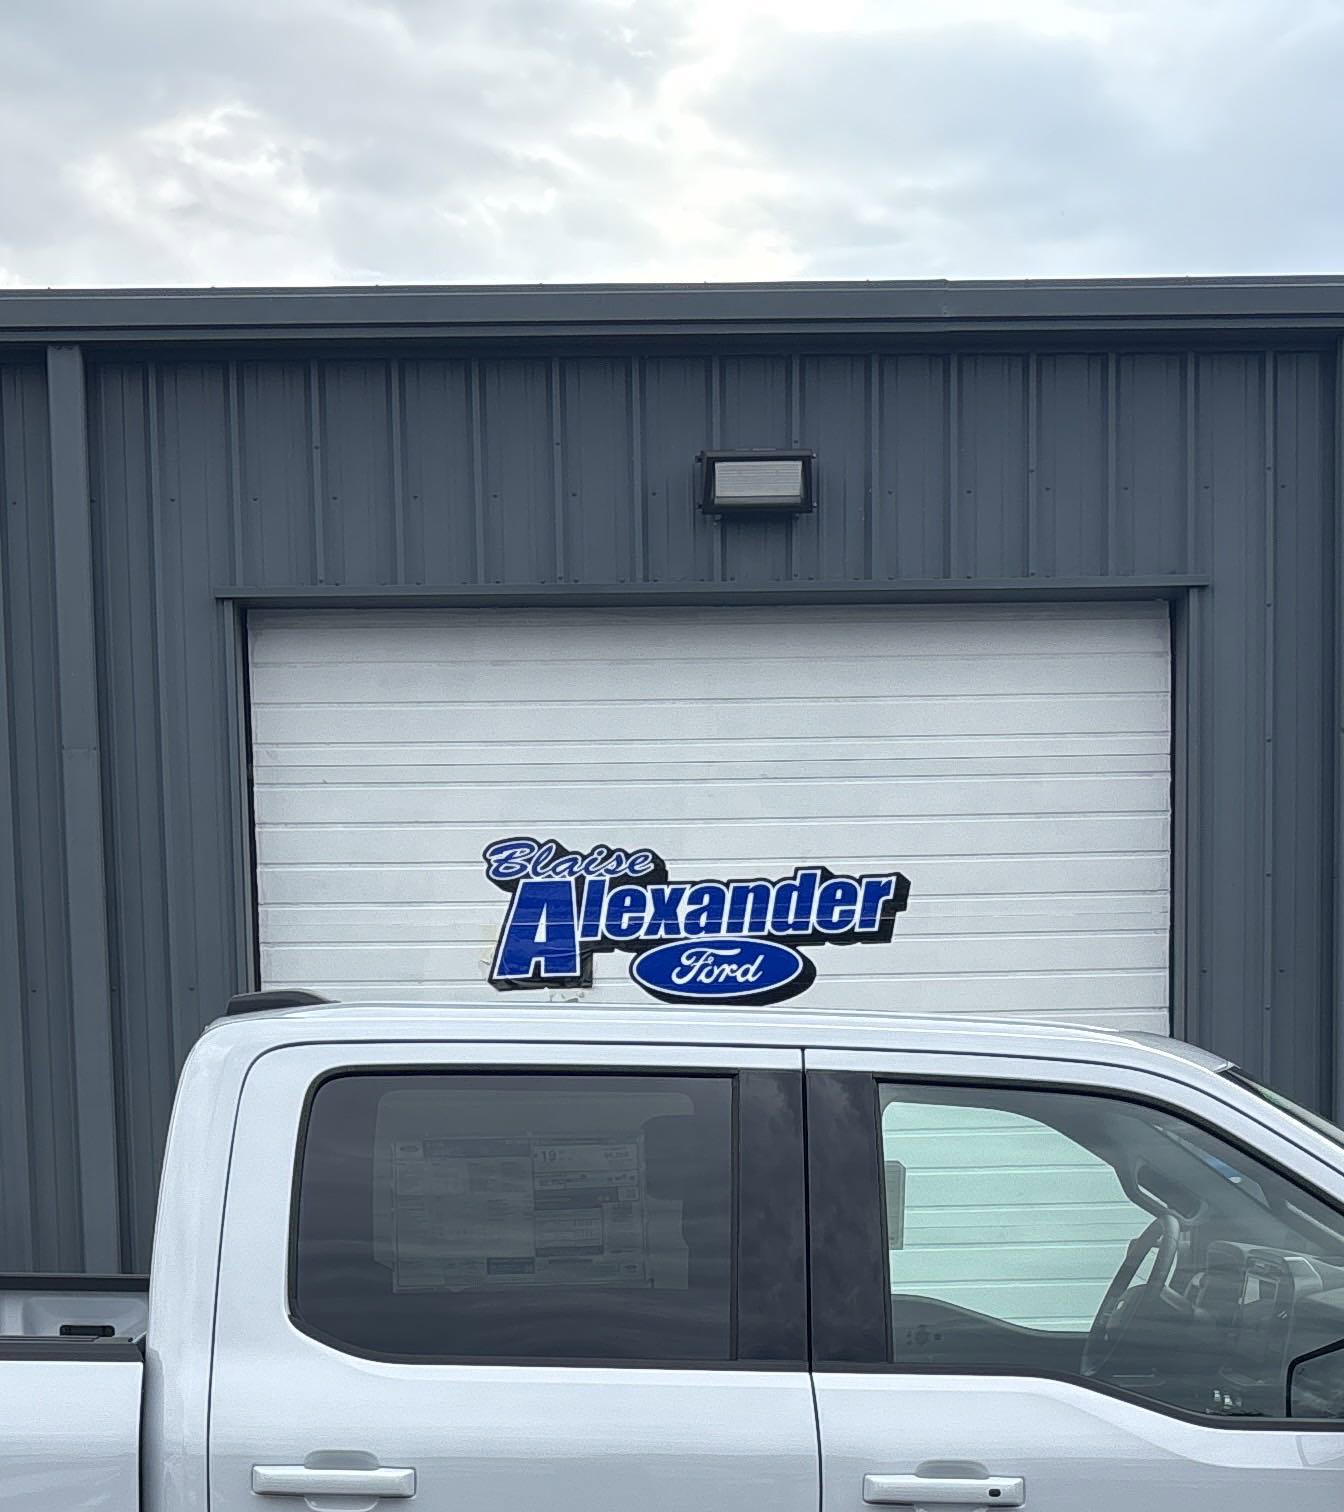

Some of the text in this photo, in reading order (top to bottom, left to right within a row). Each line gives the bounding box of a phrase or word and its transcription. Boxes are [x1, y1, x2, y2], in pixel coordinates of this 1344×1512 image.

[485, 838, 656, 881] Blaise
[491, 868, 904, 981] Alexander
[670, 946, 764, 986] Ford
